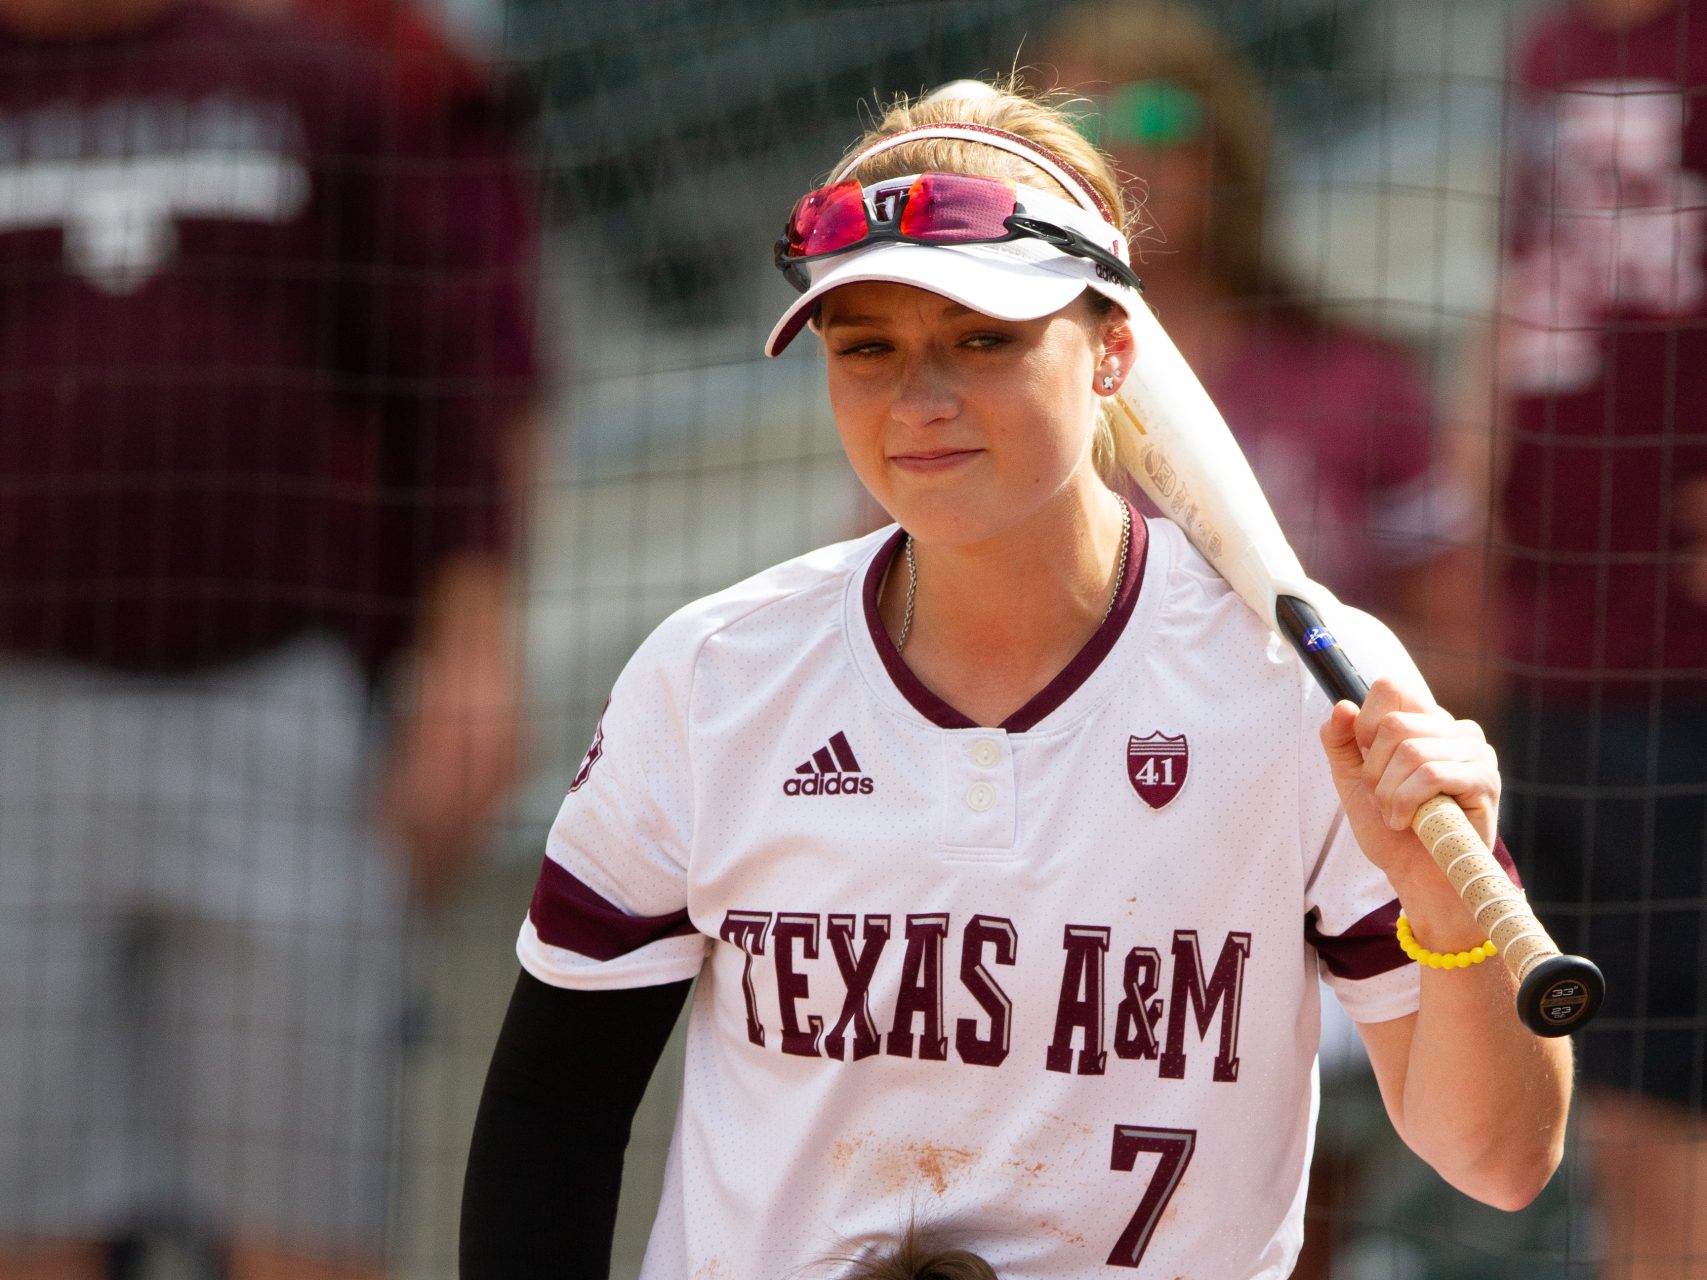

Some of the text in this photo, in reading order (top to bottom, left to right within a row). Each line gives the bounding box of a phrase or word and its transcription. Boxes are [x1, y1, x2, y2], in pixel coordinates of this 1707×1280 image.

[783, 771, 874, 796] adidas
[1135, 757, 1176, 785] 41
[720, 909, 1252, 1083] TEXAS A&M
[1105, 1123, 1198, 1269] 7
